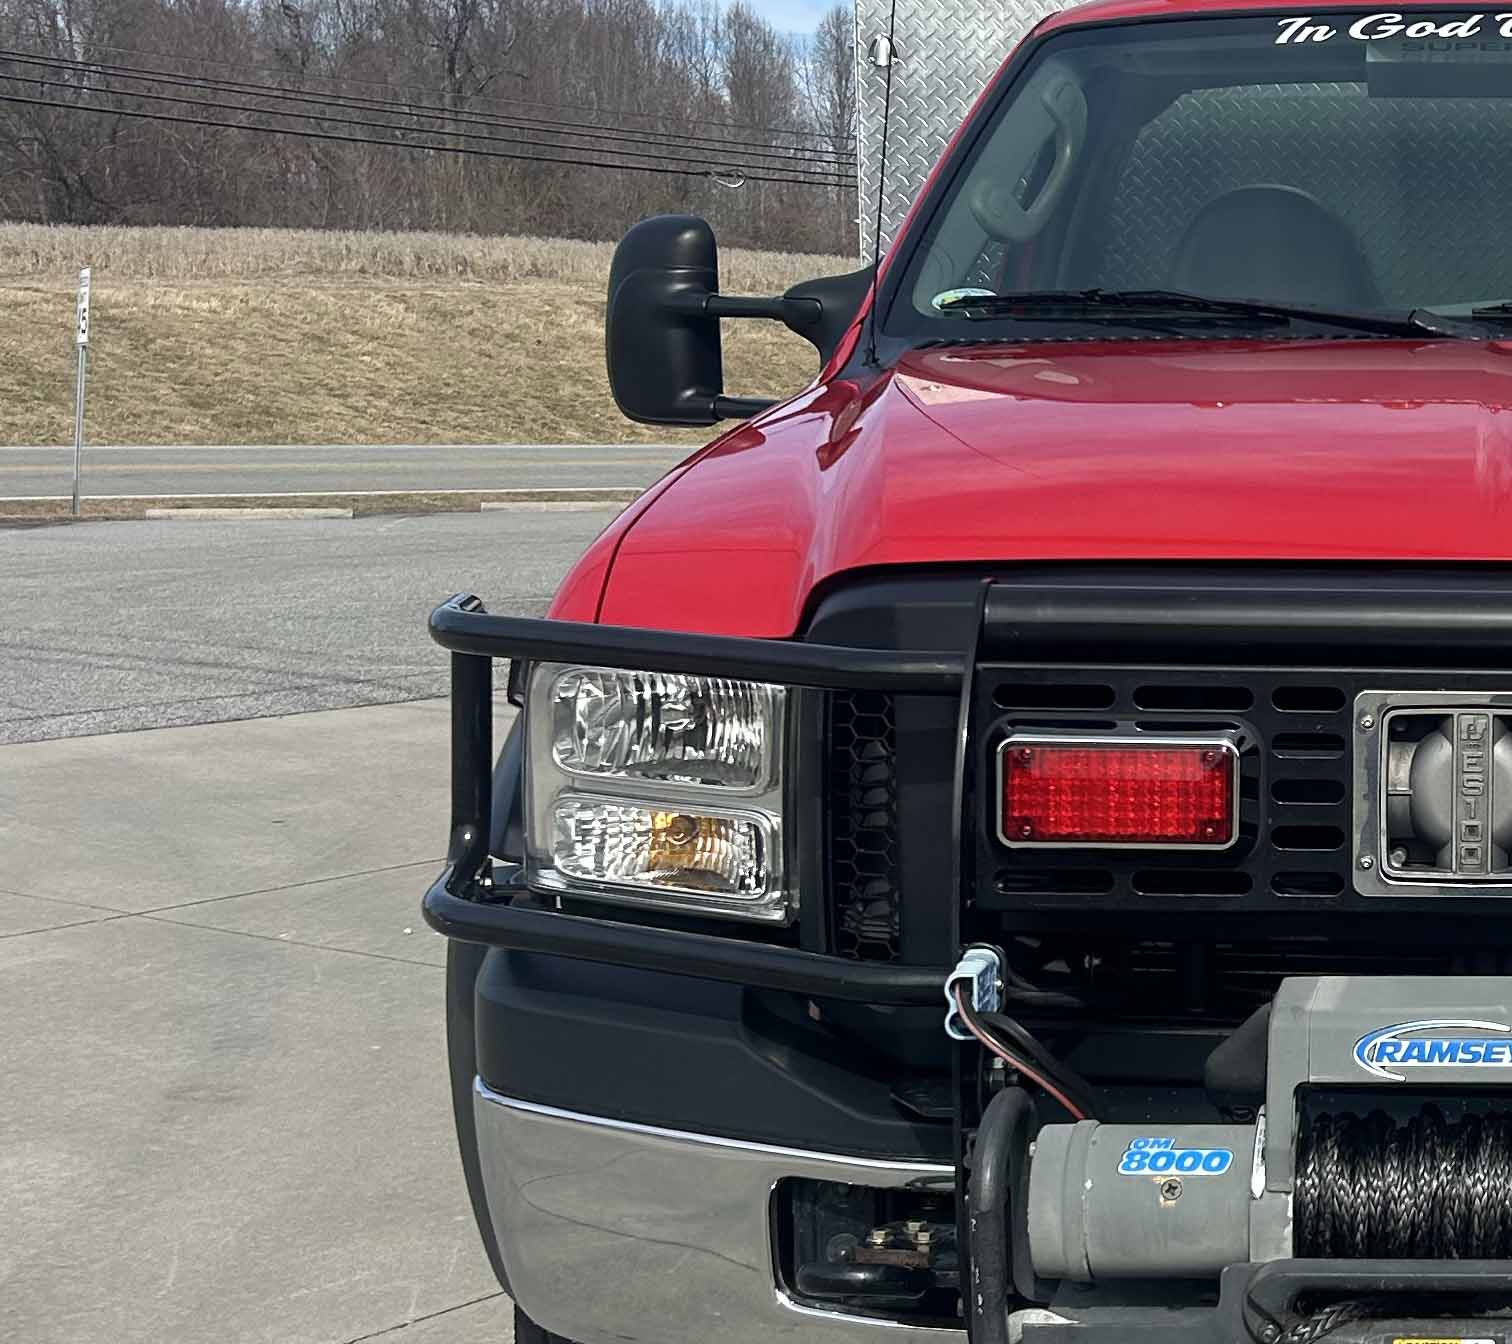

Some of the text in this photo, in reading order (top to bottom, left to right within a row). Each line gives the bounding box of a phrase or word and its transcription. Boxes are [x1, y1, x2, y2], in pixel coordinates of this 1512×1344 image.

[1275, 17, 1336, 44] In
[1349, 13, 1484, 40] God
[1121, 1150, 1231, 1172] 8000
